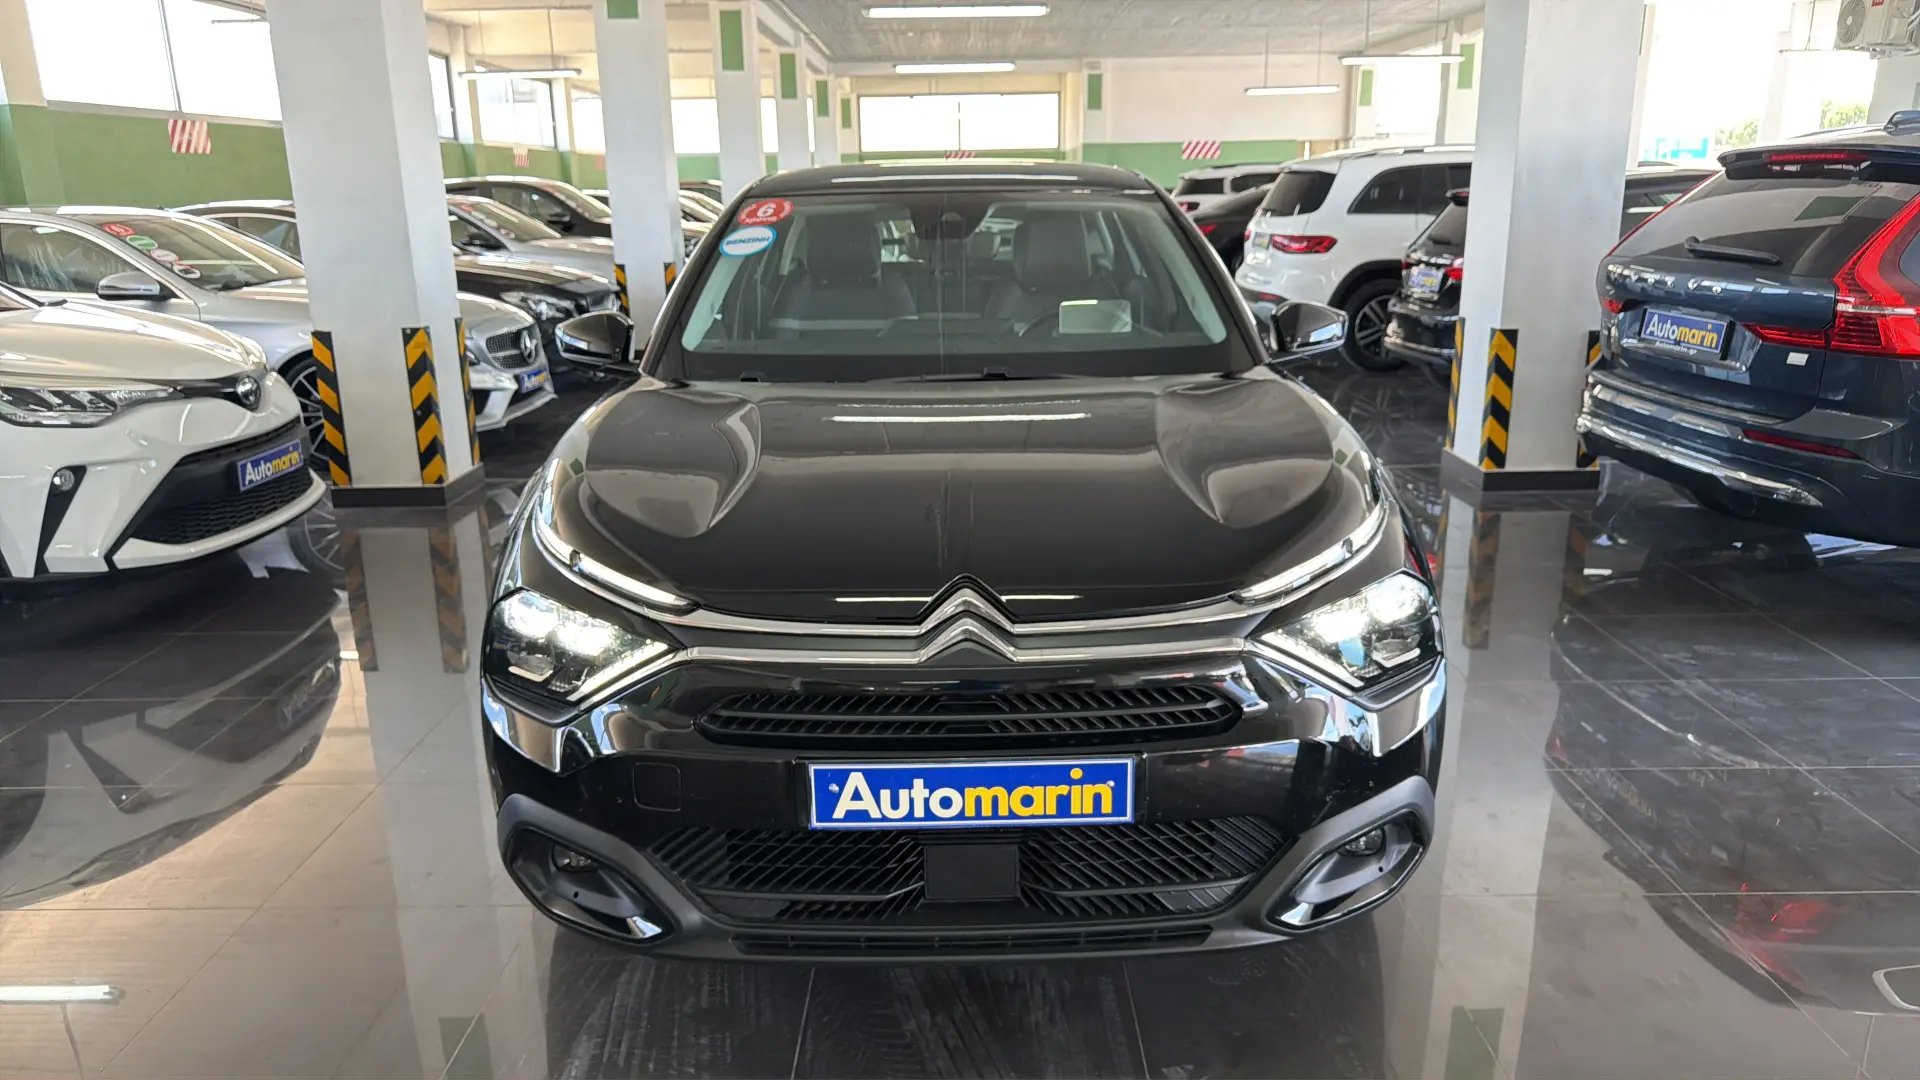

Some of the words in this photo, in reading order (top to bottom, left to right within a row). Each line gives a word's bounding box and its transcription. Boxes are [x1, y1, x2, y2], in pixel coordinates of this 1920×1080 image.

[757, 203, 777, 217] 6
[1646, 314, 1718, 348] Automarin
[245, 446, 300, 486] Automarin
[832, 767, 1112, 819] Automarin
